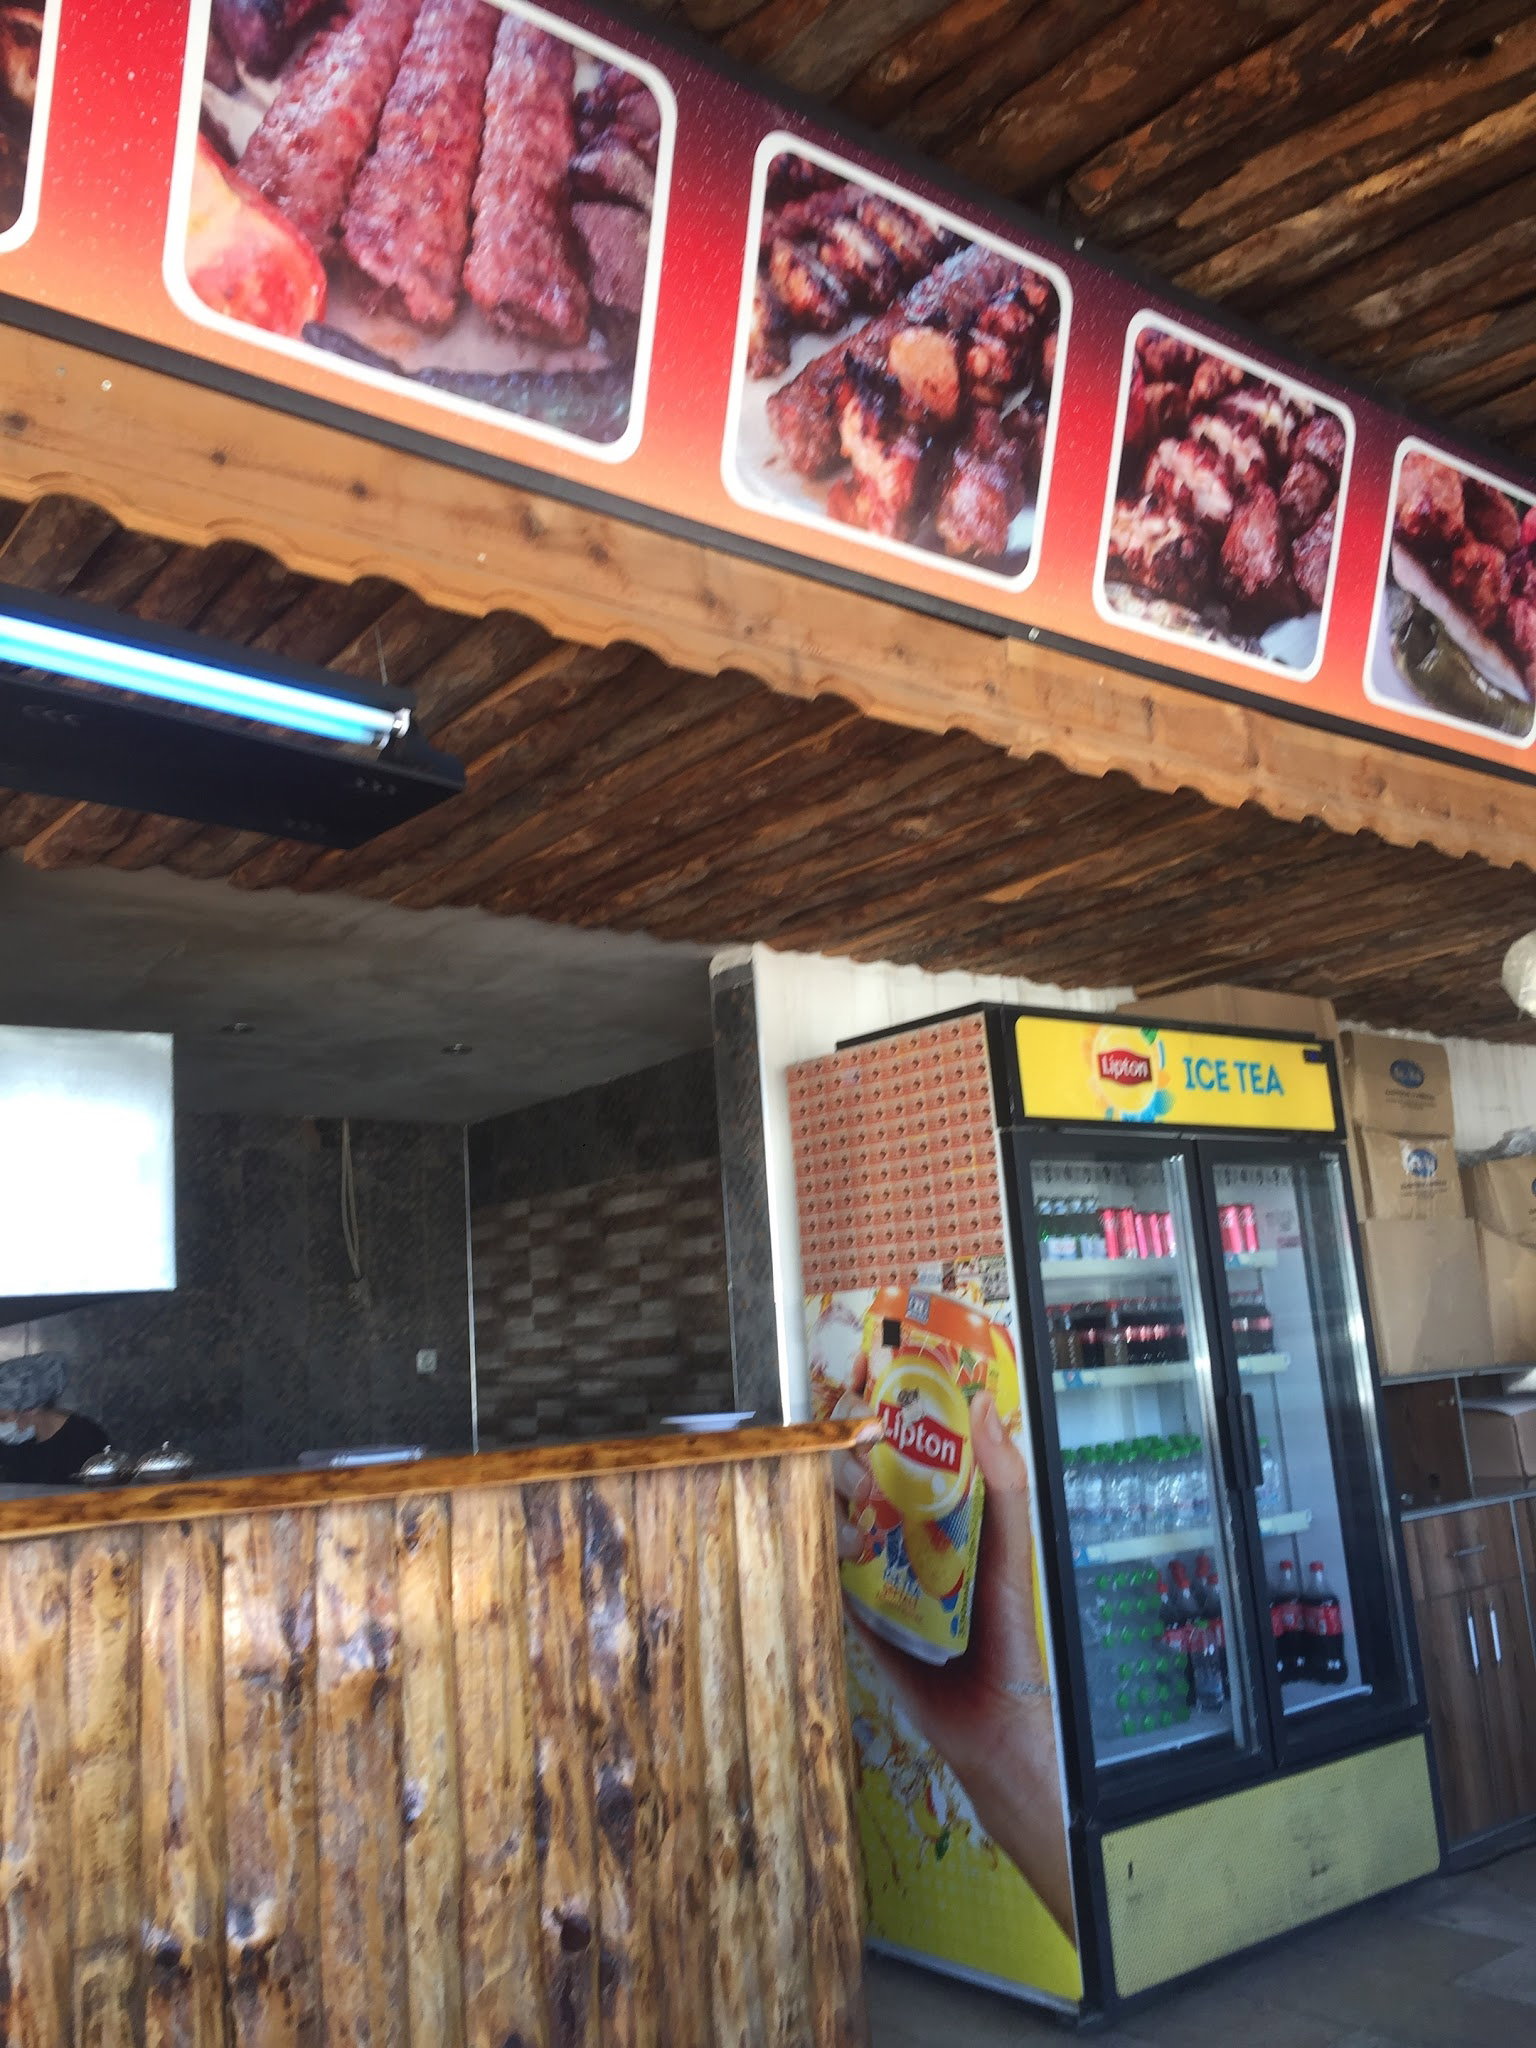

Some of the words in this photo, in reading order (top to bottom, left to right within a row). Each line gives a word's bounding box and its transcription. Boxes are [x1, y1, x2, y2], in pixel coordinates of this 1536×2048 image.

[1101, 1055, 1149, 1079] Lipton
[1183, 1056, 1230, 1092] ICE
[1233, 1060, 1285, 1096] TEA
[881, 1406, 957, 1466] Lipton
